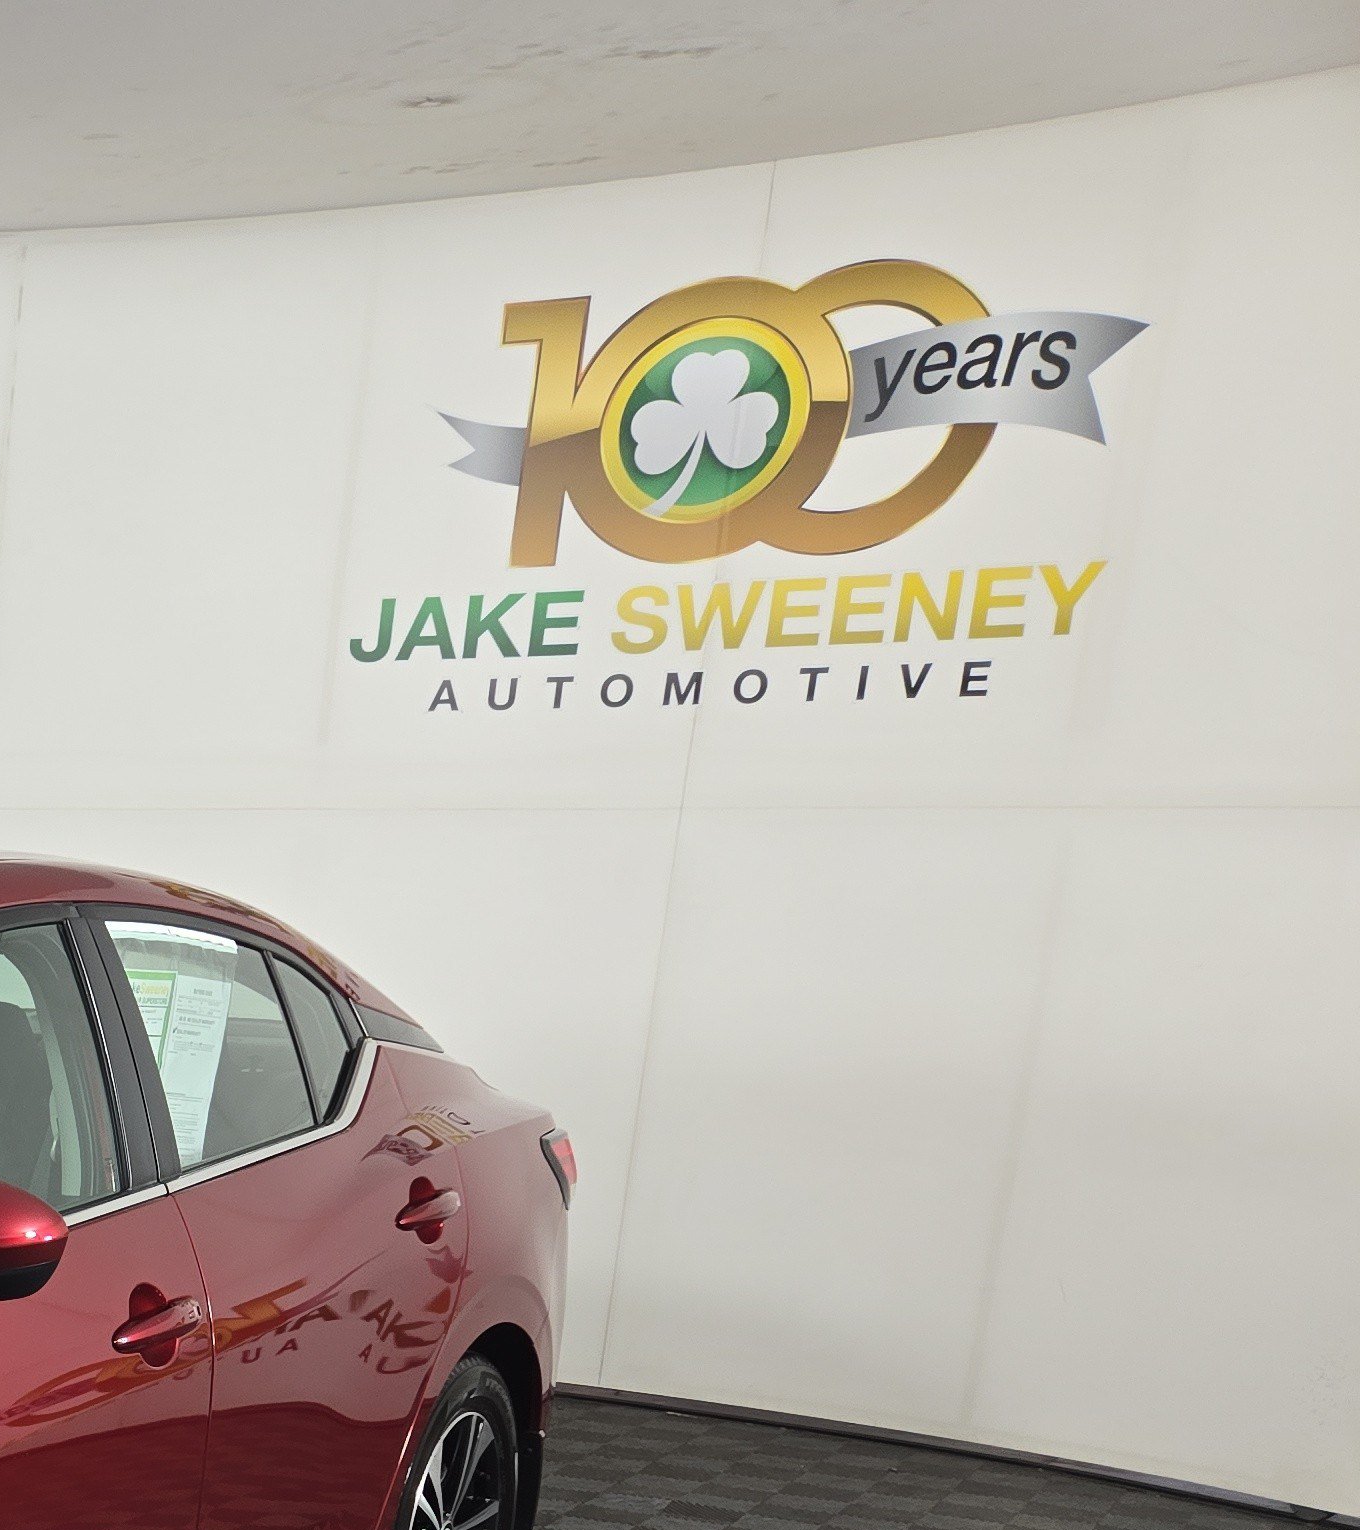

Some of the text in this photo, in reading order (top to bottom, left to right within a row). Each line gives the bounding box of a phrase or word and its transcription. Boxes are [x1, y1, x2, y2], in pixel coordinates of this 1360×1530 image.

[863, 328, 1077, 423] years
[348, 560, 1109, 664] JAKE SWEENEY
[427, 659, 994, 713] AUTOMOTIVE
